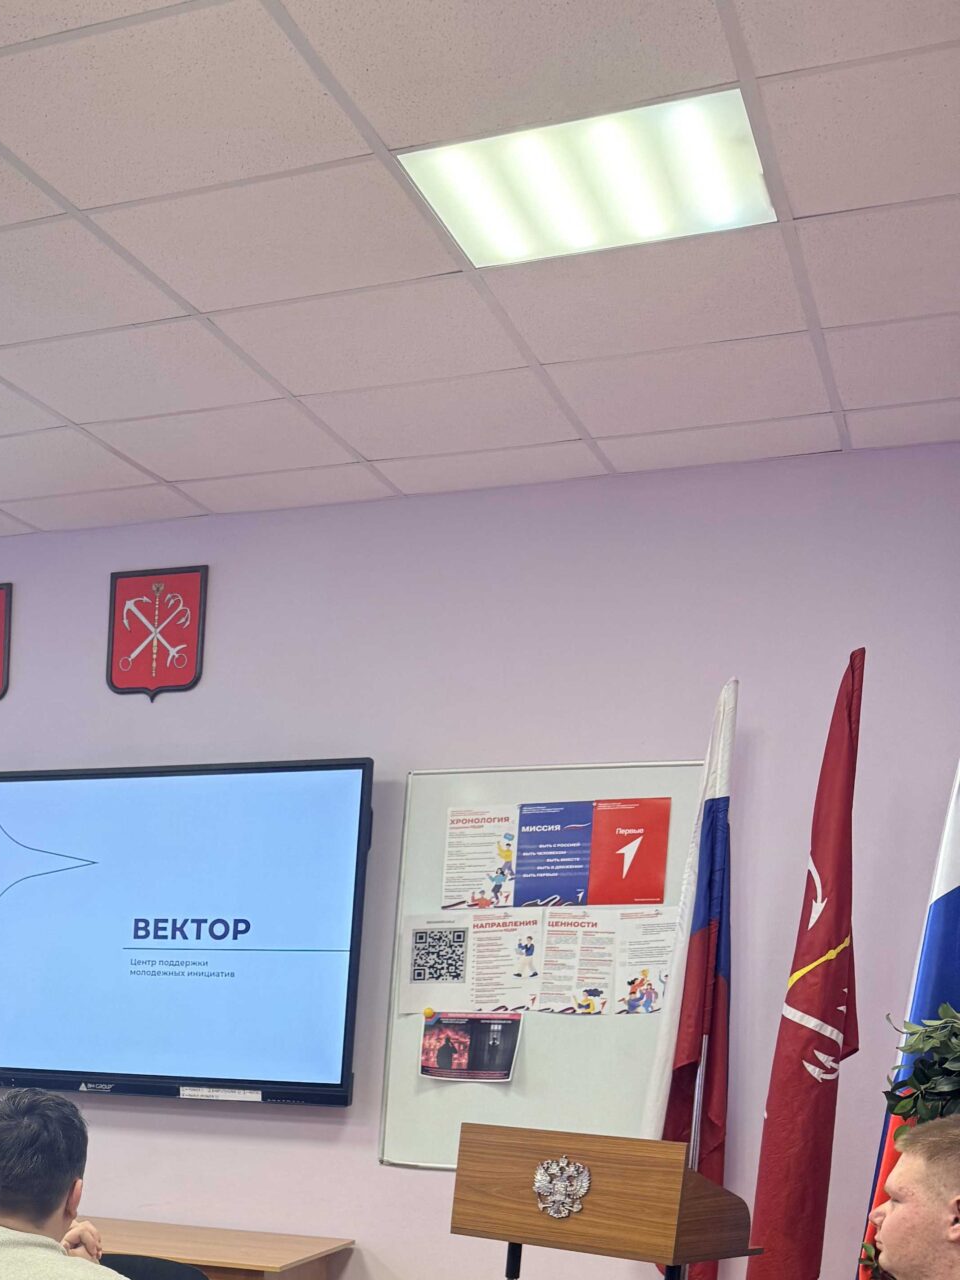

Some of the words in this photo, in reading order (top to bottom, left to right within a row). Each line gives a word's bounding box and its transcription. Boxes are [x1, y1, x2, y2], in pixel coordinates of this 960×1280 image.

[450, 816, 510, 825] ХРОНОЛОГИЯ
[521, 824, 561, 832] МИССИЯ
[616, 827, 644, 837] Первые
[472, 919, 538, 929] НАПРАВЛЕНИЯ
[133, 918, 251, 940] ВЕКТОР
[130, 959, 157, 967] Центр
[158, 960, 209, 968] поддержки
[130, 969, 186, 977] молодежных
